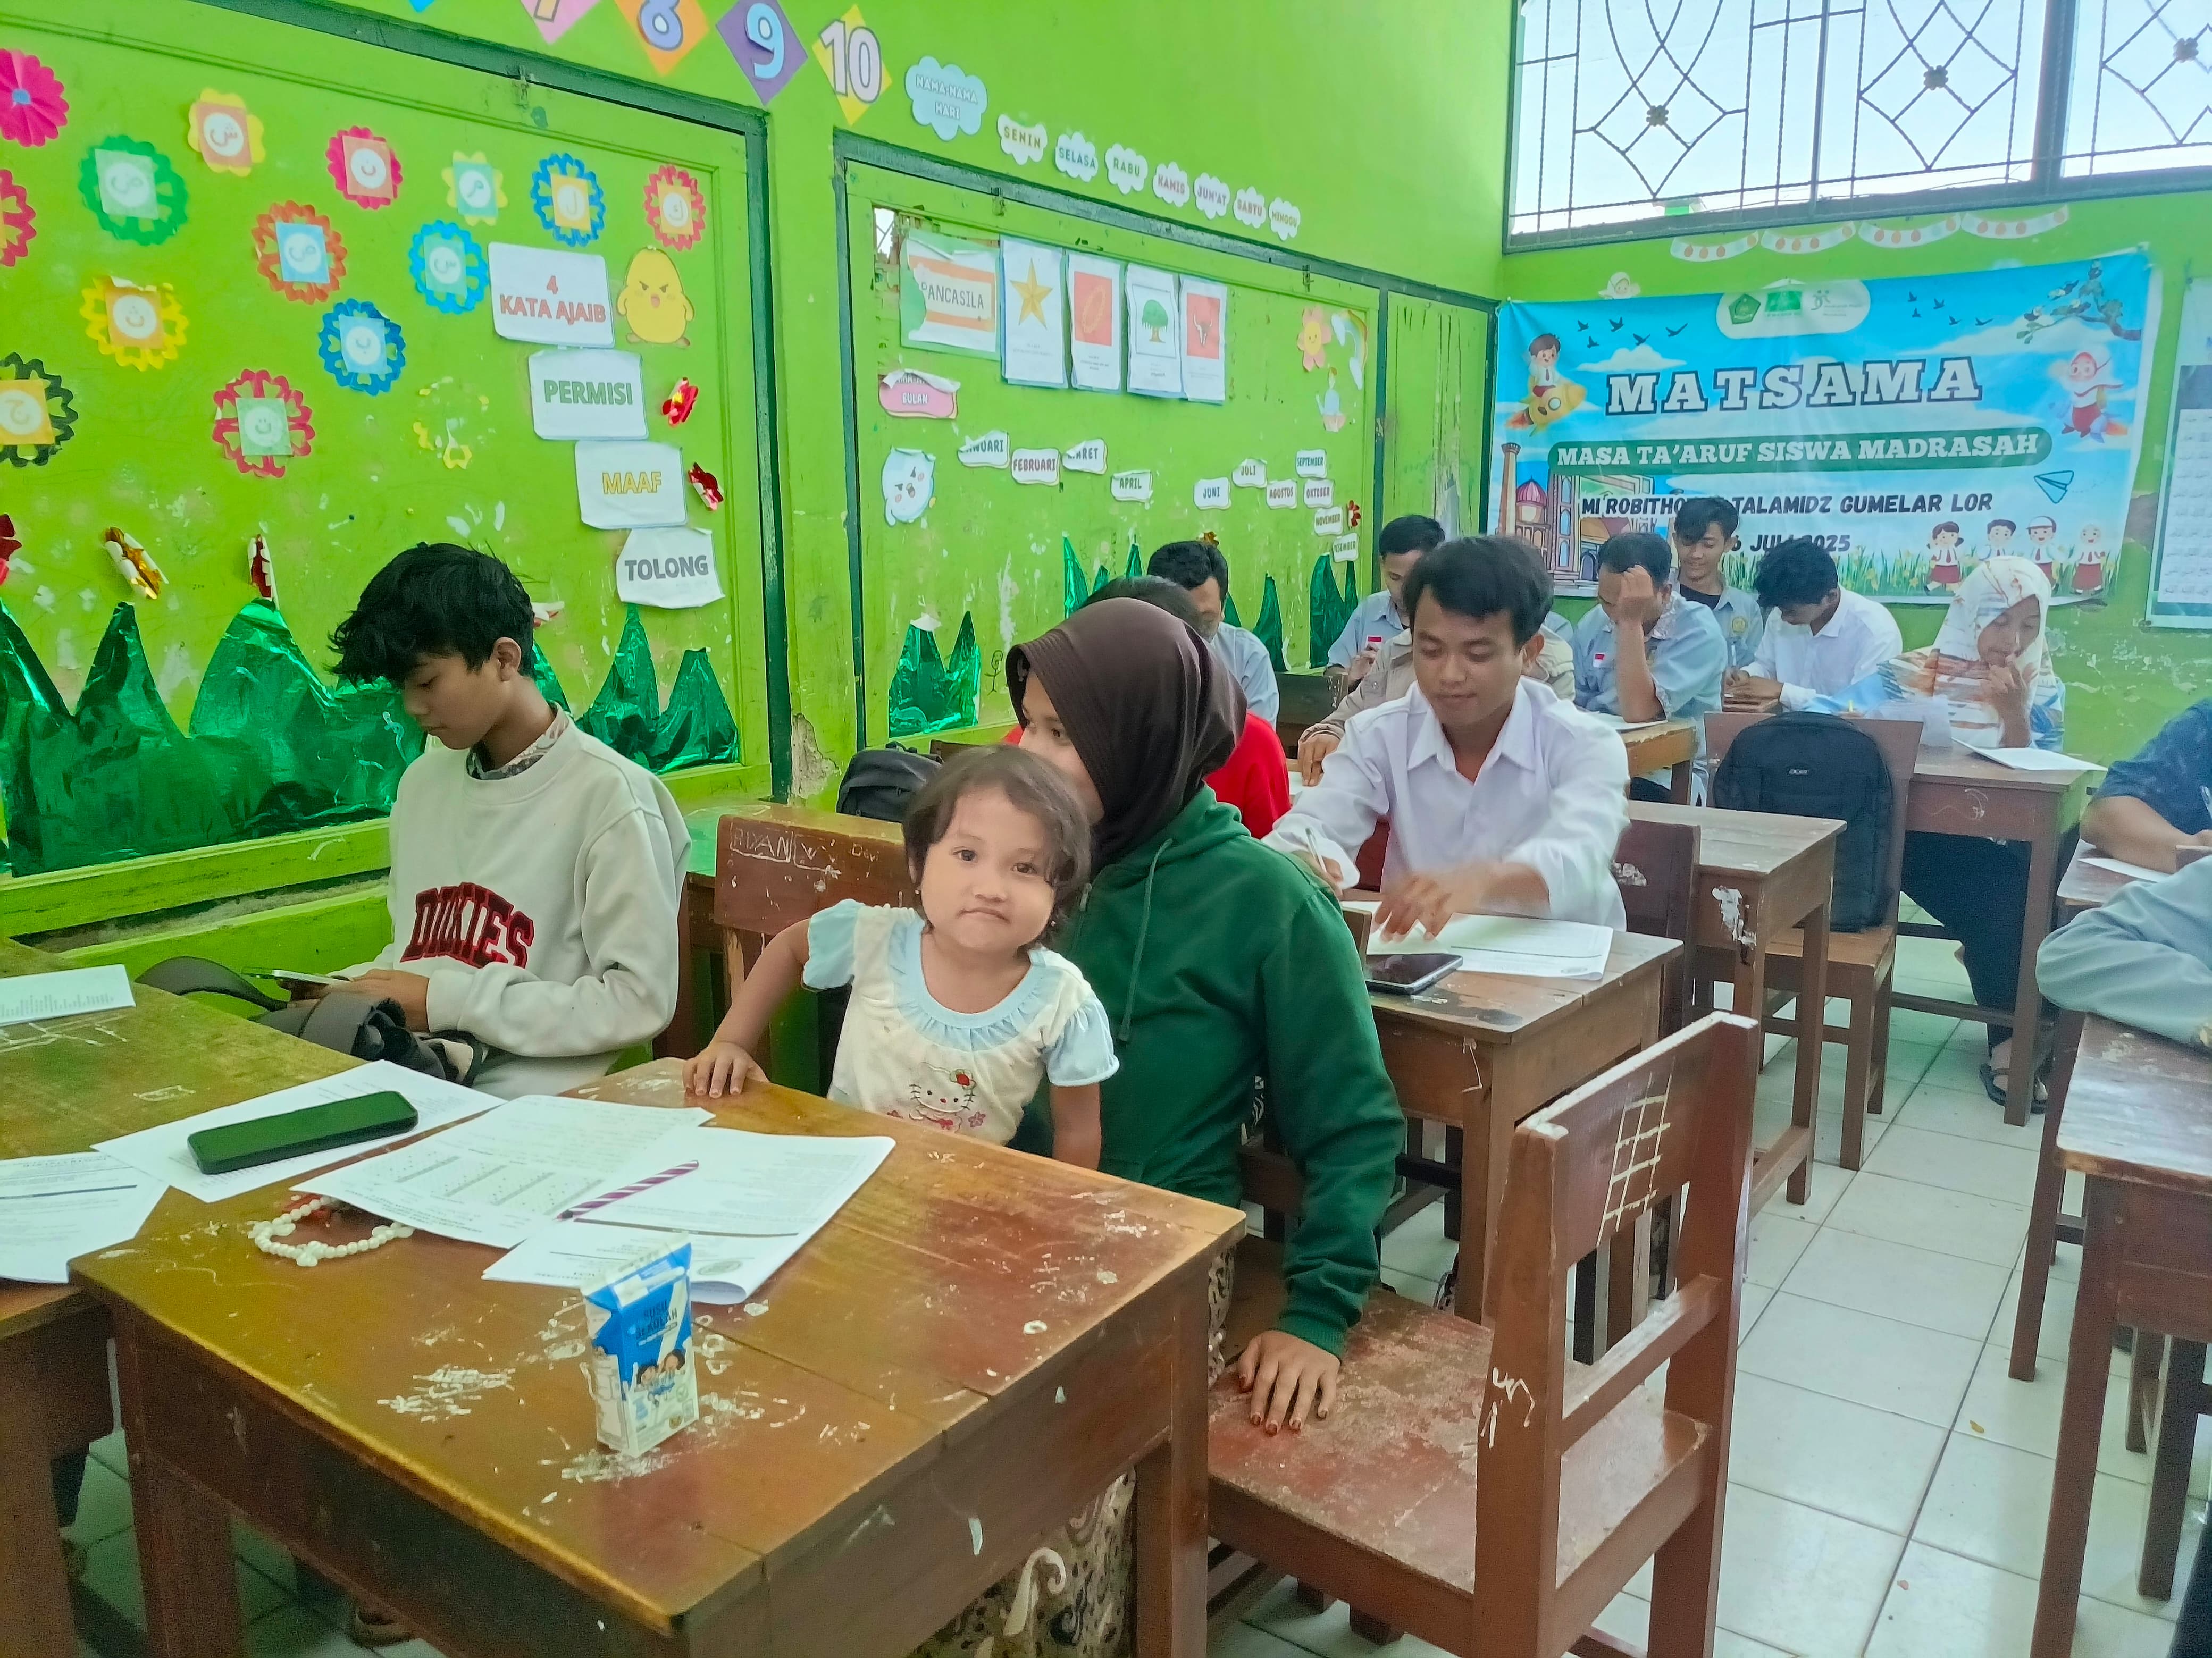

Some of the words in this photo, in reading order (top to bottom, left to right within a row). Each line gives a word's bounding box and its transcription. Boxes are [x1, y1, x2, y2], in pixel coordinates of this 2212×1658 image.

[746, 3, 785, 79] 9
[818, 19, 883, 104] 10
[915, 73, 979, 105] NAMA-NAMA
[935, 102, 961, 120] HARI
[1003, 125, 1041, 149] SENIN
[1059, 147, 1096, 170] SELASA
[1113, 156, 1141, 178] RABU
[1157, 174, 1186, 195] KAMIS
[1196, 184, 1227, 207] JUM'AT
[1236, 198, 1263, 218] SABTU
[1271, 209, 1297, 228] MINGGU
[546, 275, 559, 294] 4
[921, 281, 984, 309] PANCASILA
[500, 294, 552, 319] KATA
[556, 301, 606, 325] AJAIB
[544, 379, 633, 406] PERMISI
[1605, 356, 1983, 416] MATSAMA
[901, 392, 928, 405] BULAN
[961, 439, 1004, 453] NUARI
[1068, 447, 1099, 460] ARET
[1557, 445, 1631, 466] MASA
[1637, 442, 1753, 465] TA'ARUF
[1757, 439, 1852, 462] SISWA
[1857, 433, 2039, 460] MADRASAH
[1013, 458, 1056, 472] FEBRUARI
[1241, 465, 1256, 476] JULI
[1297, 456, 1323, 467] SEPTEMBER
[602, 471, 663, 495] MAAF
[1119, 477, 1142, 490] APRIL
[1202, 486, 1220, 499] JUNI
[1306, 486, 1330, 499] OKTOBER
[1582, 500, 1601, 516] MI
[1732, 495, 1832, 514] TALAMIDZ
[1840, 494, 1942, 514] GUMELAR
[1951, 493, 1993, 512] LOR
[1316, 513, 1340, 526] NOVEMBER
[624, 554, 709, 582] TOLONG
